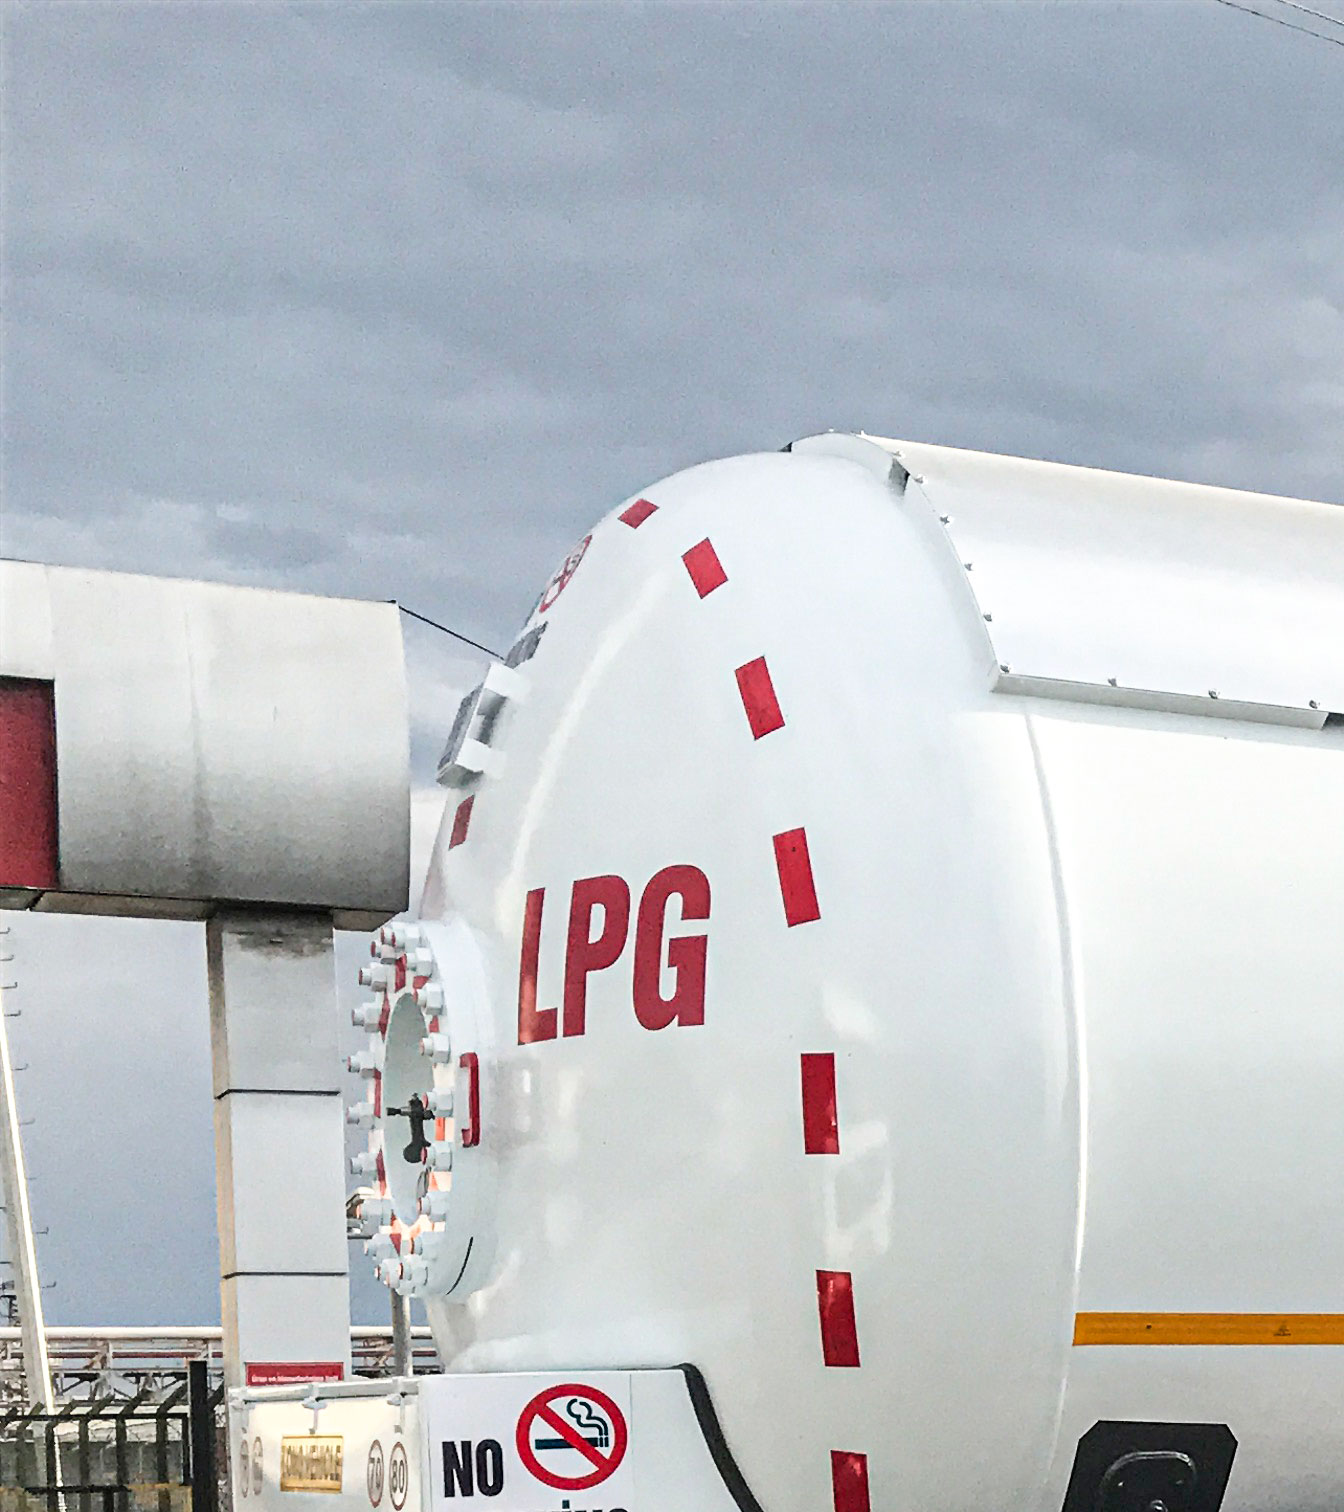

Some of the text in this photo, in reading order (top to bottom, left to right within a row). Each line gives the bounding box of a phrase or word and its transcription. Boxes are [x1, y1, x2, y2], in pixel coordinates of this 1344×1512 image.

[517, 864, 711, 1046] LPG
[369, 1457, 381, 1490] 70
[391, 1460, 405, 1494] 80
[442, 1439, 504, 1498] NO
